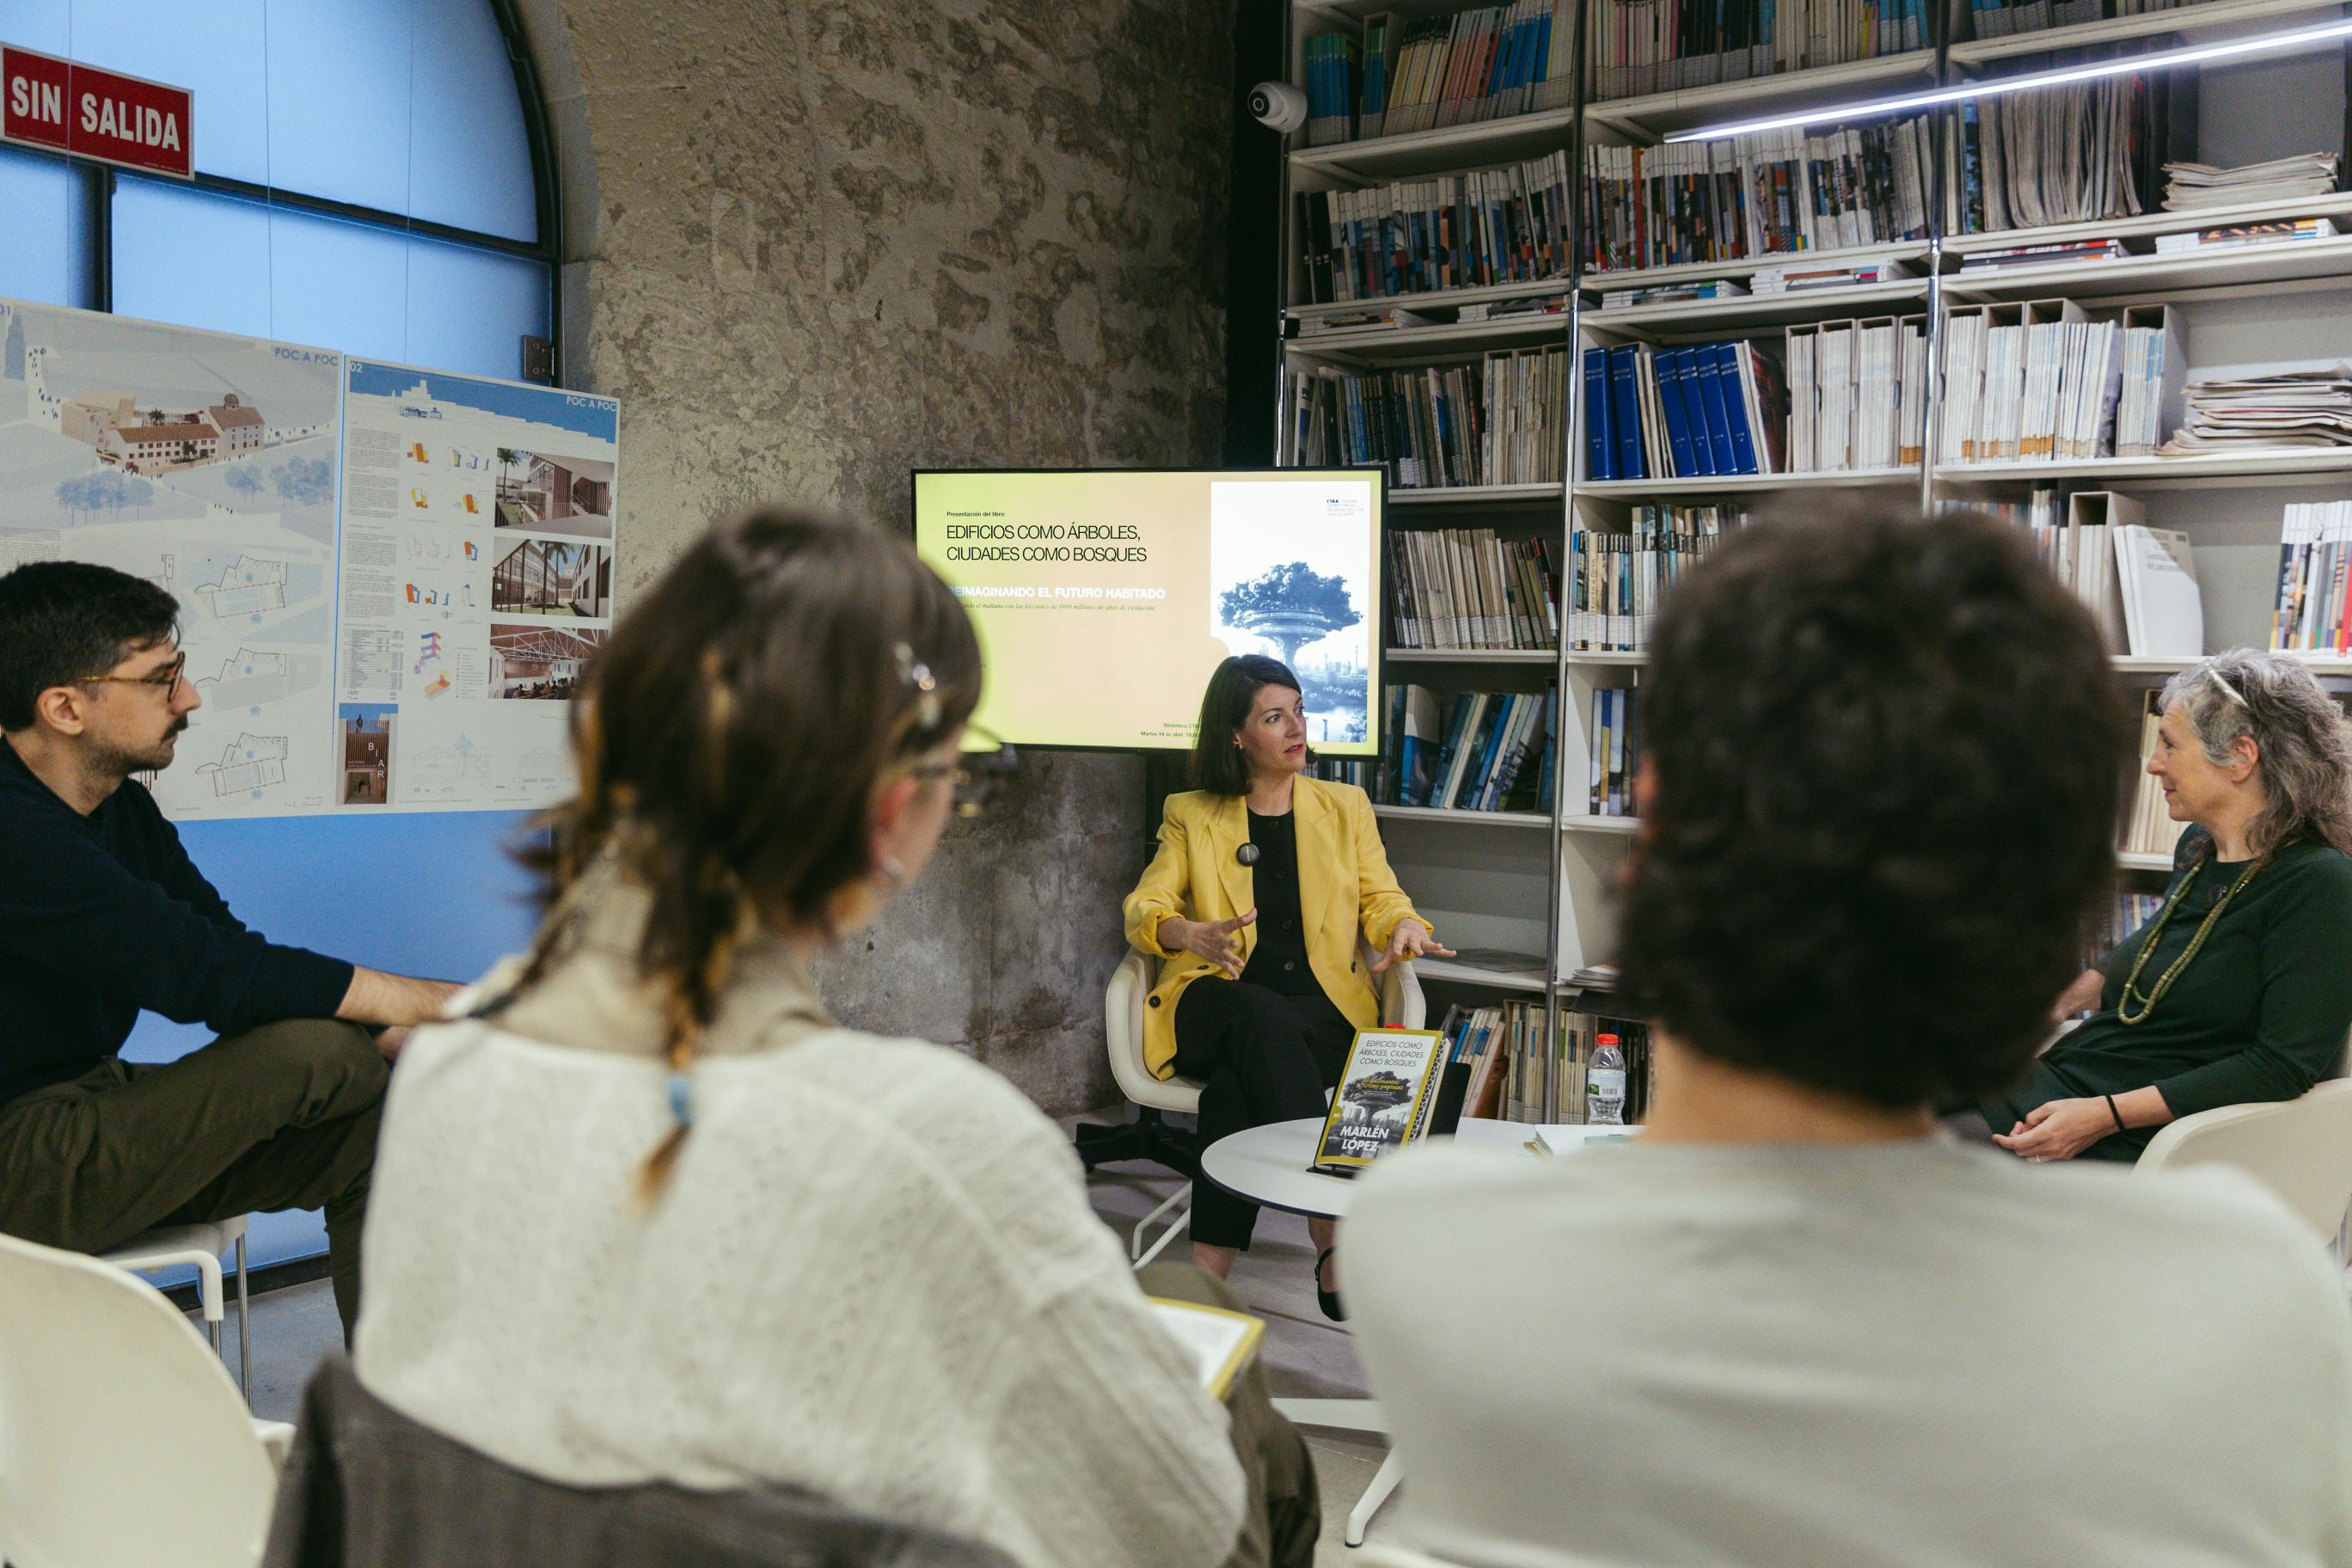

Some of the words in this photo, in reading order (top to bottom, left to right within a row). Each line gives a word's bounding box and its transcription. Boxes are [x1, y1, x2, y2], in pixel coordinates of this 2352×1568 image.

[12, 76, 61, 125] SIN
[81, 93, 181, 151] SALIDA
[275, 347, 299, 360] POC
[303, 352, 310, 362] A
[315, 353, 338, 366] POC
[350, 363, 363, 372] 02
[567, 396, 585, 407] POC
[589, 400, 595, 408] A
[597, 401, 616, 412] POC
[946, 525, 1014, 539] EDIFICIOS
[1018, 525, 1065, 539] COMO
[1067, 522, 1141, 542] ÁRBOLES,
[946, 547, 1020, 560] CIUDADES
[1022, 547, 1070, 561] COMO
[1073, 548, 1148, 562] BOSQUES
[1038, 587, 1052, 597] EL
[1055, 587, 1103, 598] FUTURO
[1106, 588, 1166, 599] HABITADO
[1384, 1058, 1417, 1067] BOSQUES
[1340, 1124, 1389, 1139] MARLÉN
[1341, 1138, 1379, 1151] LÓPEZ
